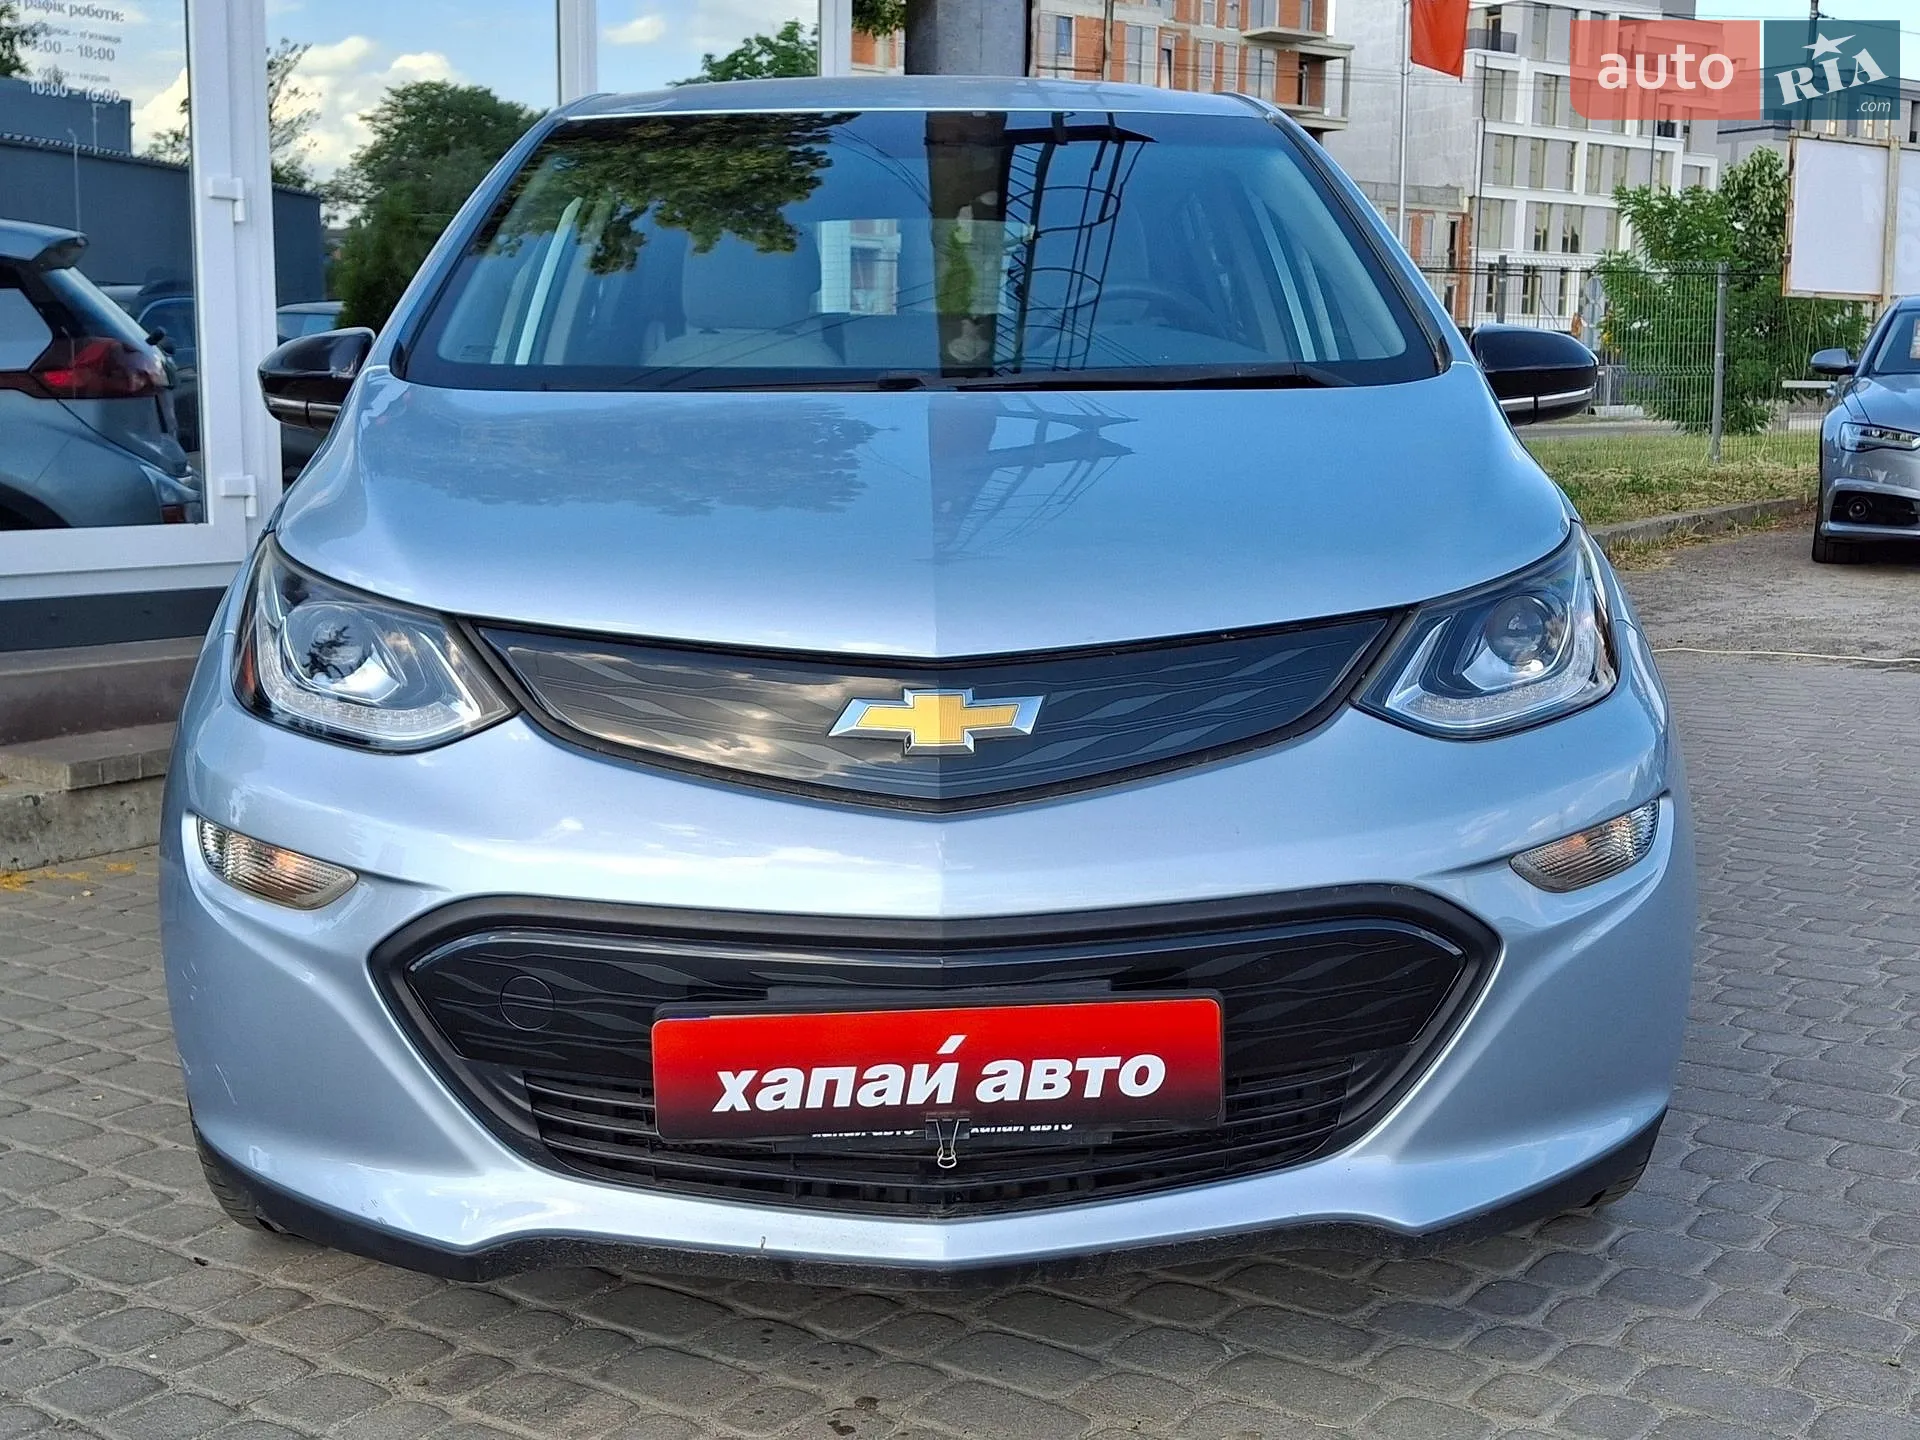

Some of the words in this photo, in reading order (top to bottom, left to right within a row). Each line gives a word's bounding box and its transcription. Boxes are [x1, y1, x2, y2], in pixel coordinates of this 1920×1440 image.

[69, 3, 125, 22] роботи:
[77, 44, 116, 61] 18:00
[29, 81, 68, 98] 10:00
[975, 1054, 1166, 1103] авто
